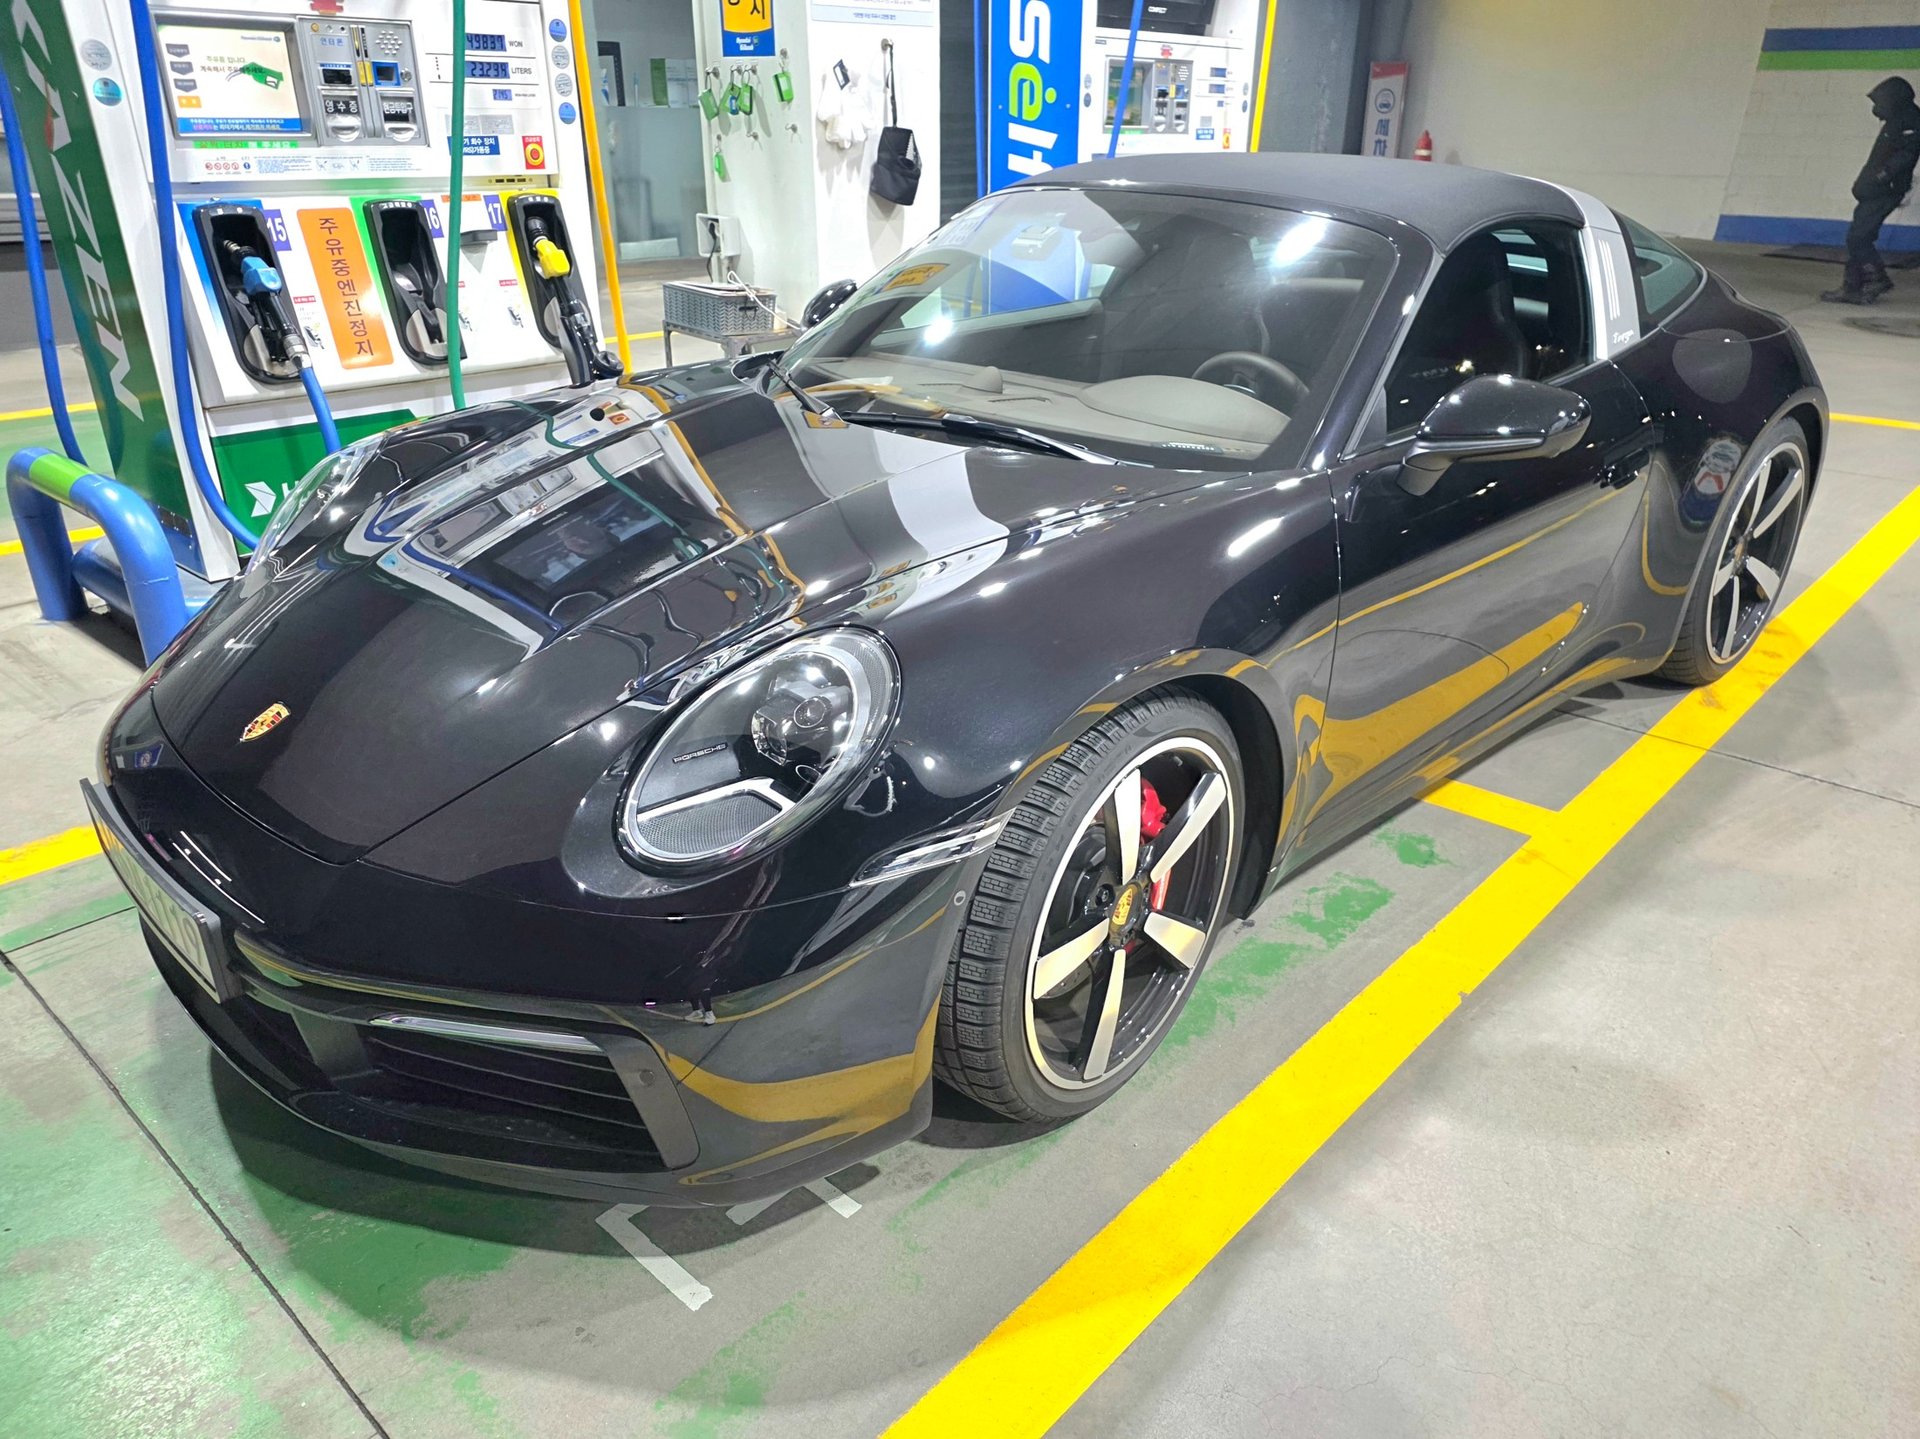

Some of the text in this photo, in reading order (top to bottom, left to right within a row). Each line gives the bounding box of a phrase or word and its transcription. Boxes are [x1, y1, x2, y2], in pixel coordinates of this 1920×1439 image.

[466, 34, 505, 50] 49837
[511, 67, 532, 75] LITERS
[325, 100, 358, 113] 영수증
[383, 102, 413, 114] 현금투입구
[424, 206, 440, 230] 16
[488, 203, 503, 225] 17
[266, 218, 288, 242] 15
[673, 743, 727, 763] PORSCHE
